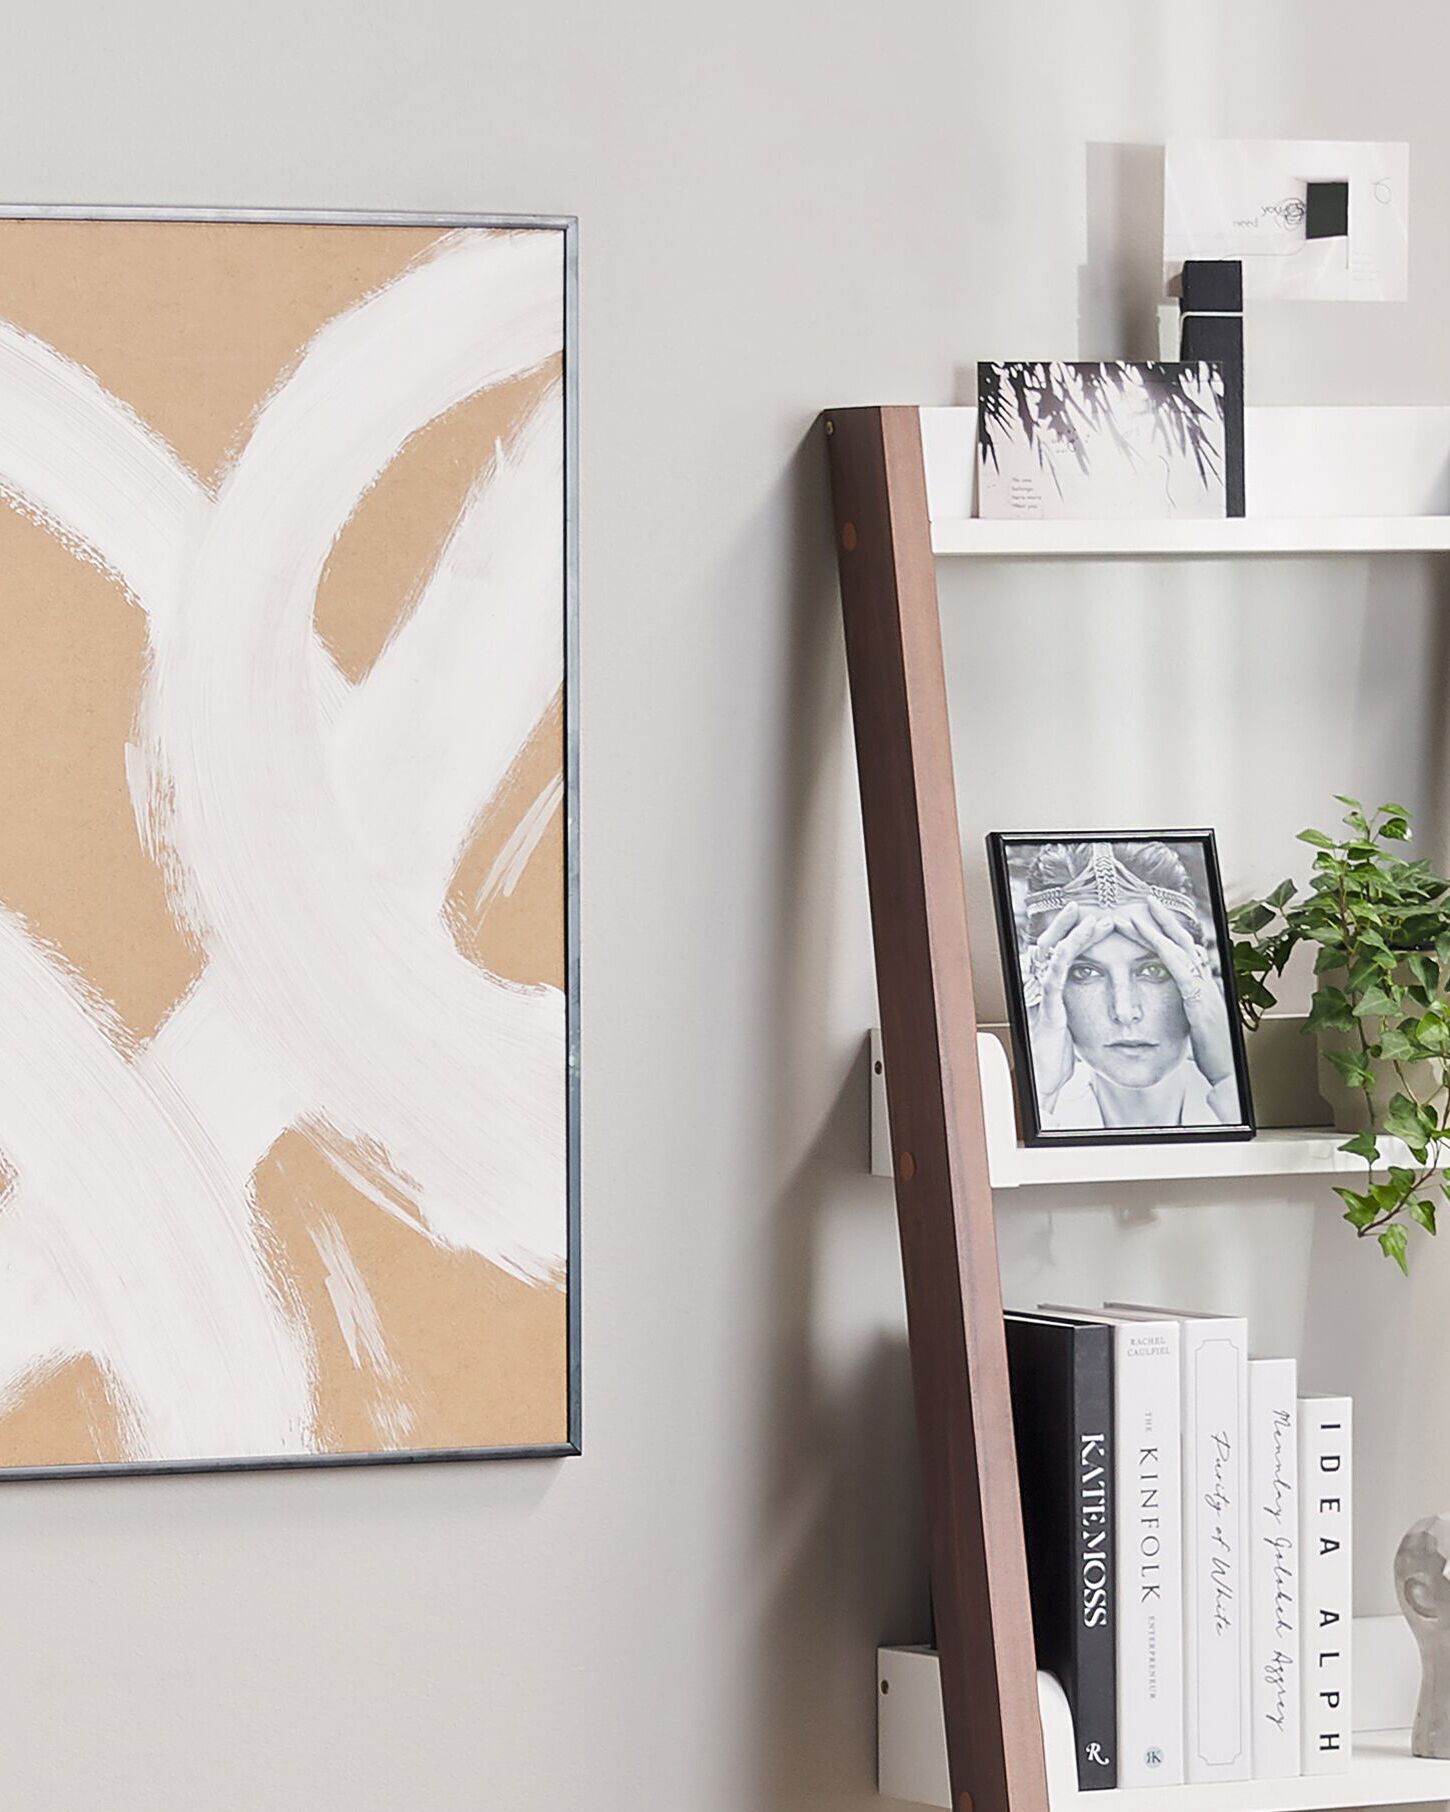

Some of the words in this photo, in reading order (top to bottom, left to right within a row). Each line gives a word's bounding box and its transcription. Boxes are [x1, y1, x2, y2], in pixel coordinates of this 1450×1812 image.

[1144, 1412, 1152, 1433] THE
[1204, 1430, 1232, 1518] Purity
[1319, 1423, 1342, 1555] IDEA
[1139, 1447, 1161, 1603] KINFOLK
[1211, 1526, 1231, 1552] of
[1210, 1556, 1233, 1637] White
[1318, 1609, 1341, 1752] ALPH
